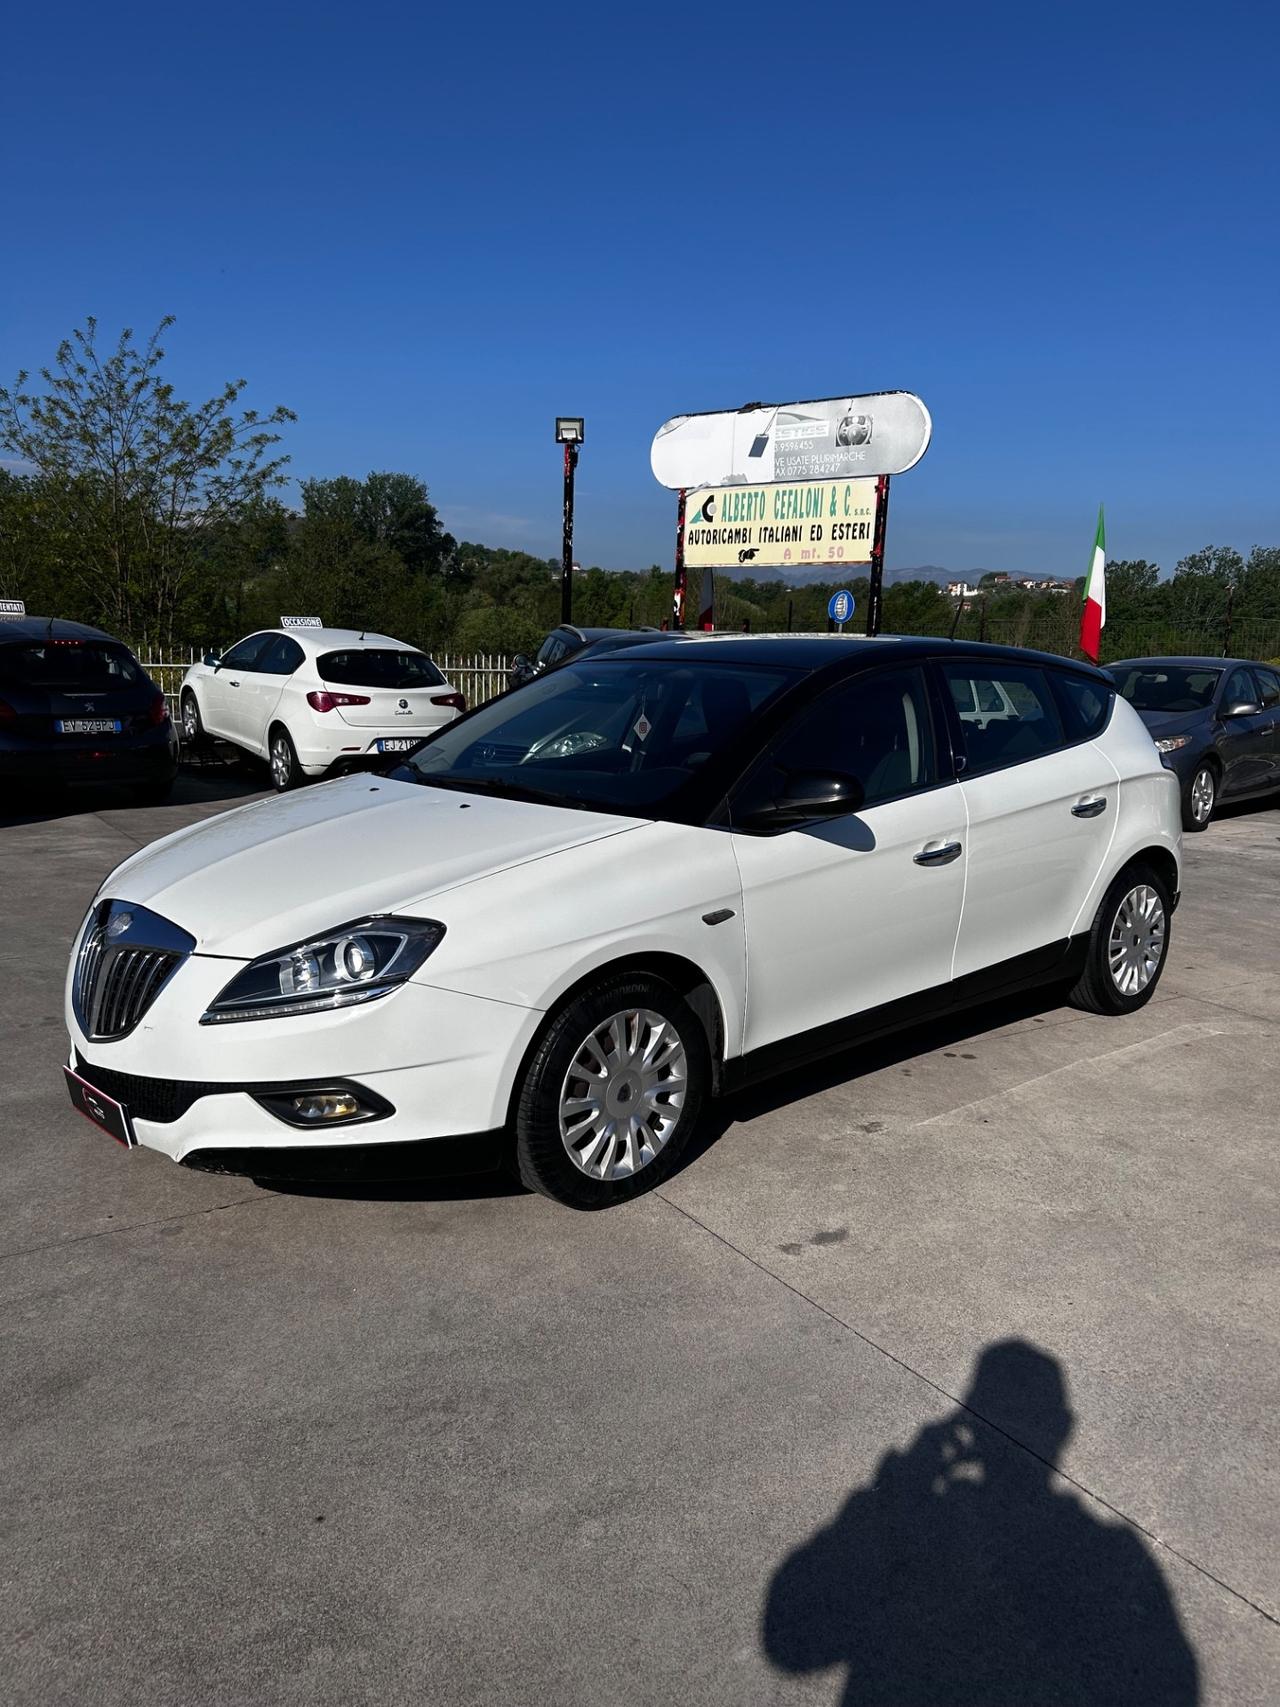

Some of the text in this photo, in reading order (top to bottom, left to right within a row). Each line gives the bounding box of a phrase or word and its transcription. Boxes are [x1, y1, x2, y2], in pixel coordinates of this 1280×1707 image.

[787, 455, 809, 466] USATE
[811, 451, 866, 464] PLURIMARCHE
[788, 465, 808, 476] 0775
[809, 463, 841, 474] 284247
[721, 490, 766, 522] ALBERTO
[774, 487, 824, 520] CEFALONI
[829, 485, 838, 517] &
[688, 522, 870, 545] AUTORICAMBI ITALIANI ED ESTERI
[783, 547, 792, 560] A
[828, 546, 845, 559] 50
[284, 618, 320, 627] OCCASIONE
[384, 740, 396, 751] EJ
